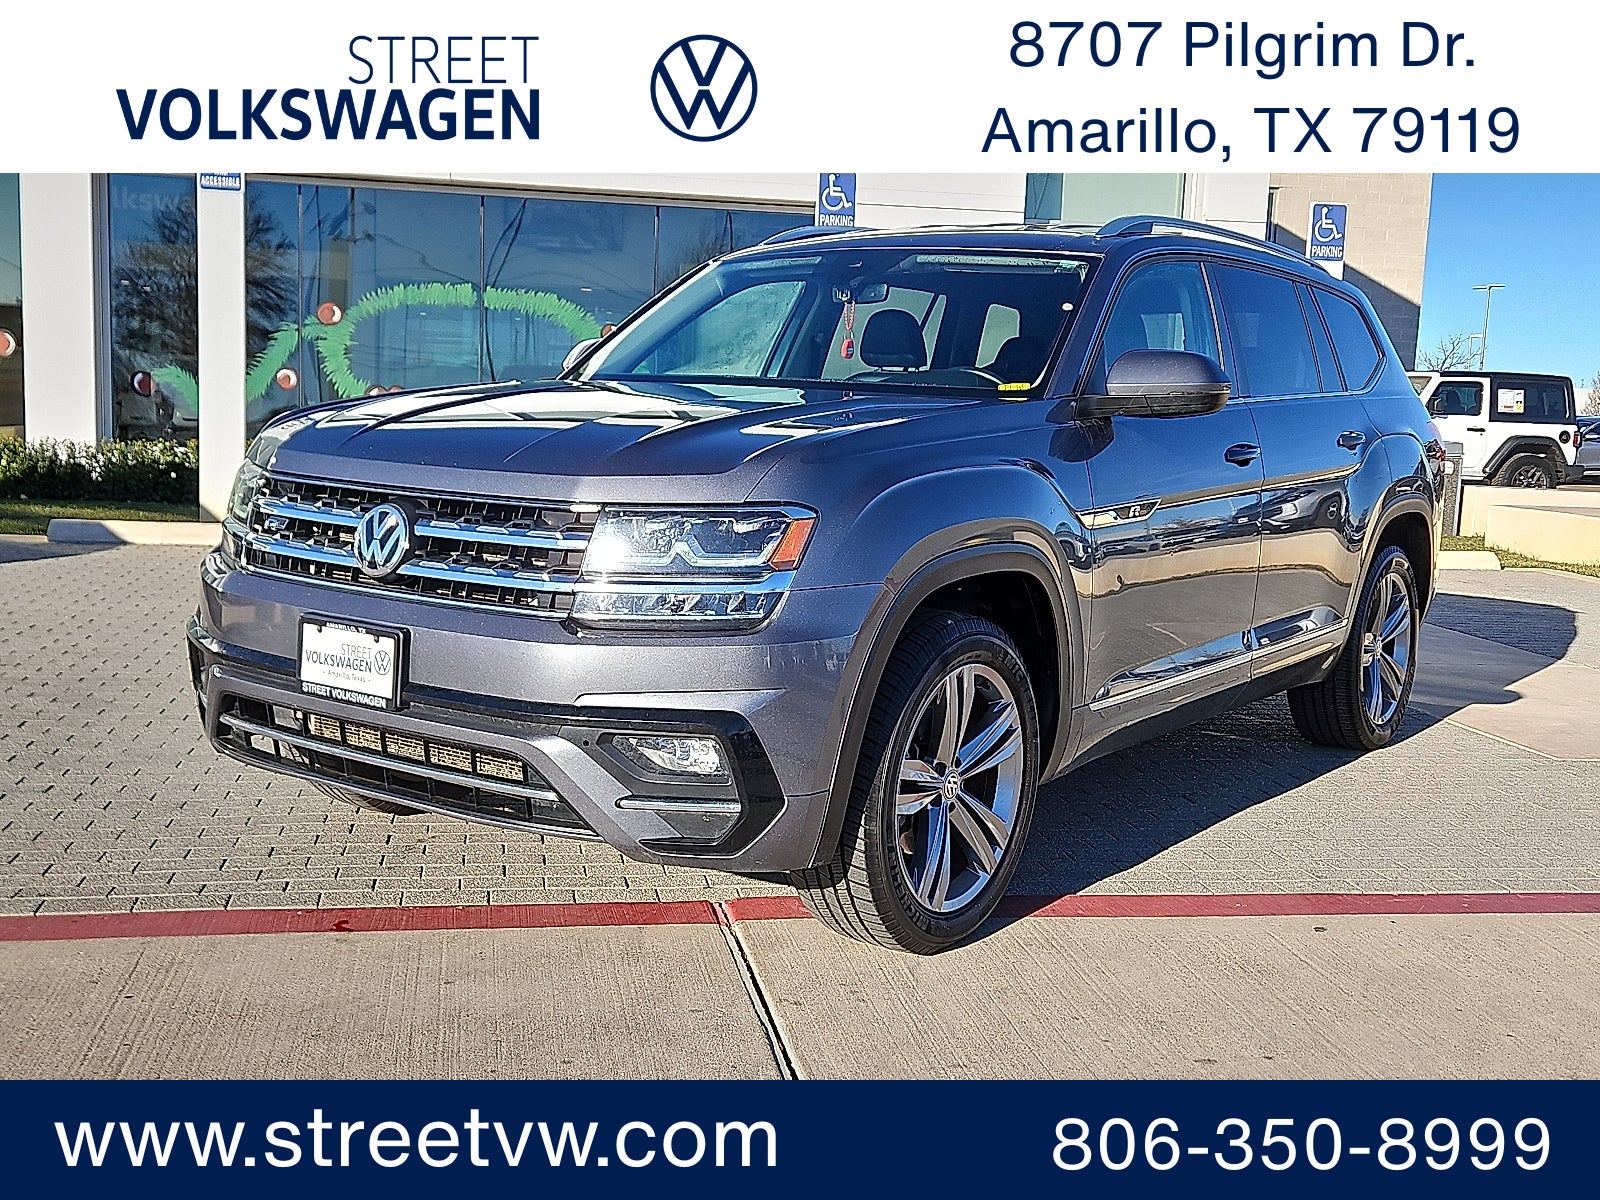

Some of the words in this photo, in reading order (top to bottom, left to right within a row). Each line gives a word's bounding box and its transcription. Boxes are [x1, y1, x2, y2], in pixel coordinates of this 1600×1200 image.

[200, 175, 241, 187] ACCESSIBLE
[820, 214, 854, 226] PARKING
[1311, 245, 1343, 258] PARKING
[340, 644, 372, 660] STREET
[305, 649, 372, 674] VOLKSWAGEN
[302, 681, 331, 698] STREET
[331, 686, 387, 709] VOLKSWAGEN
